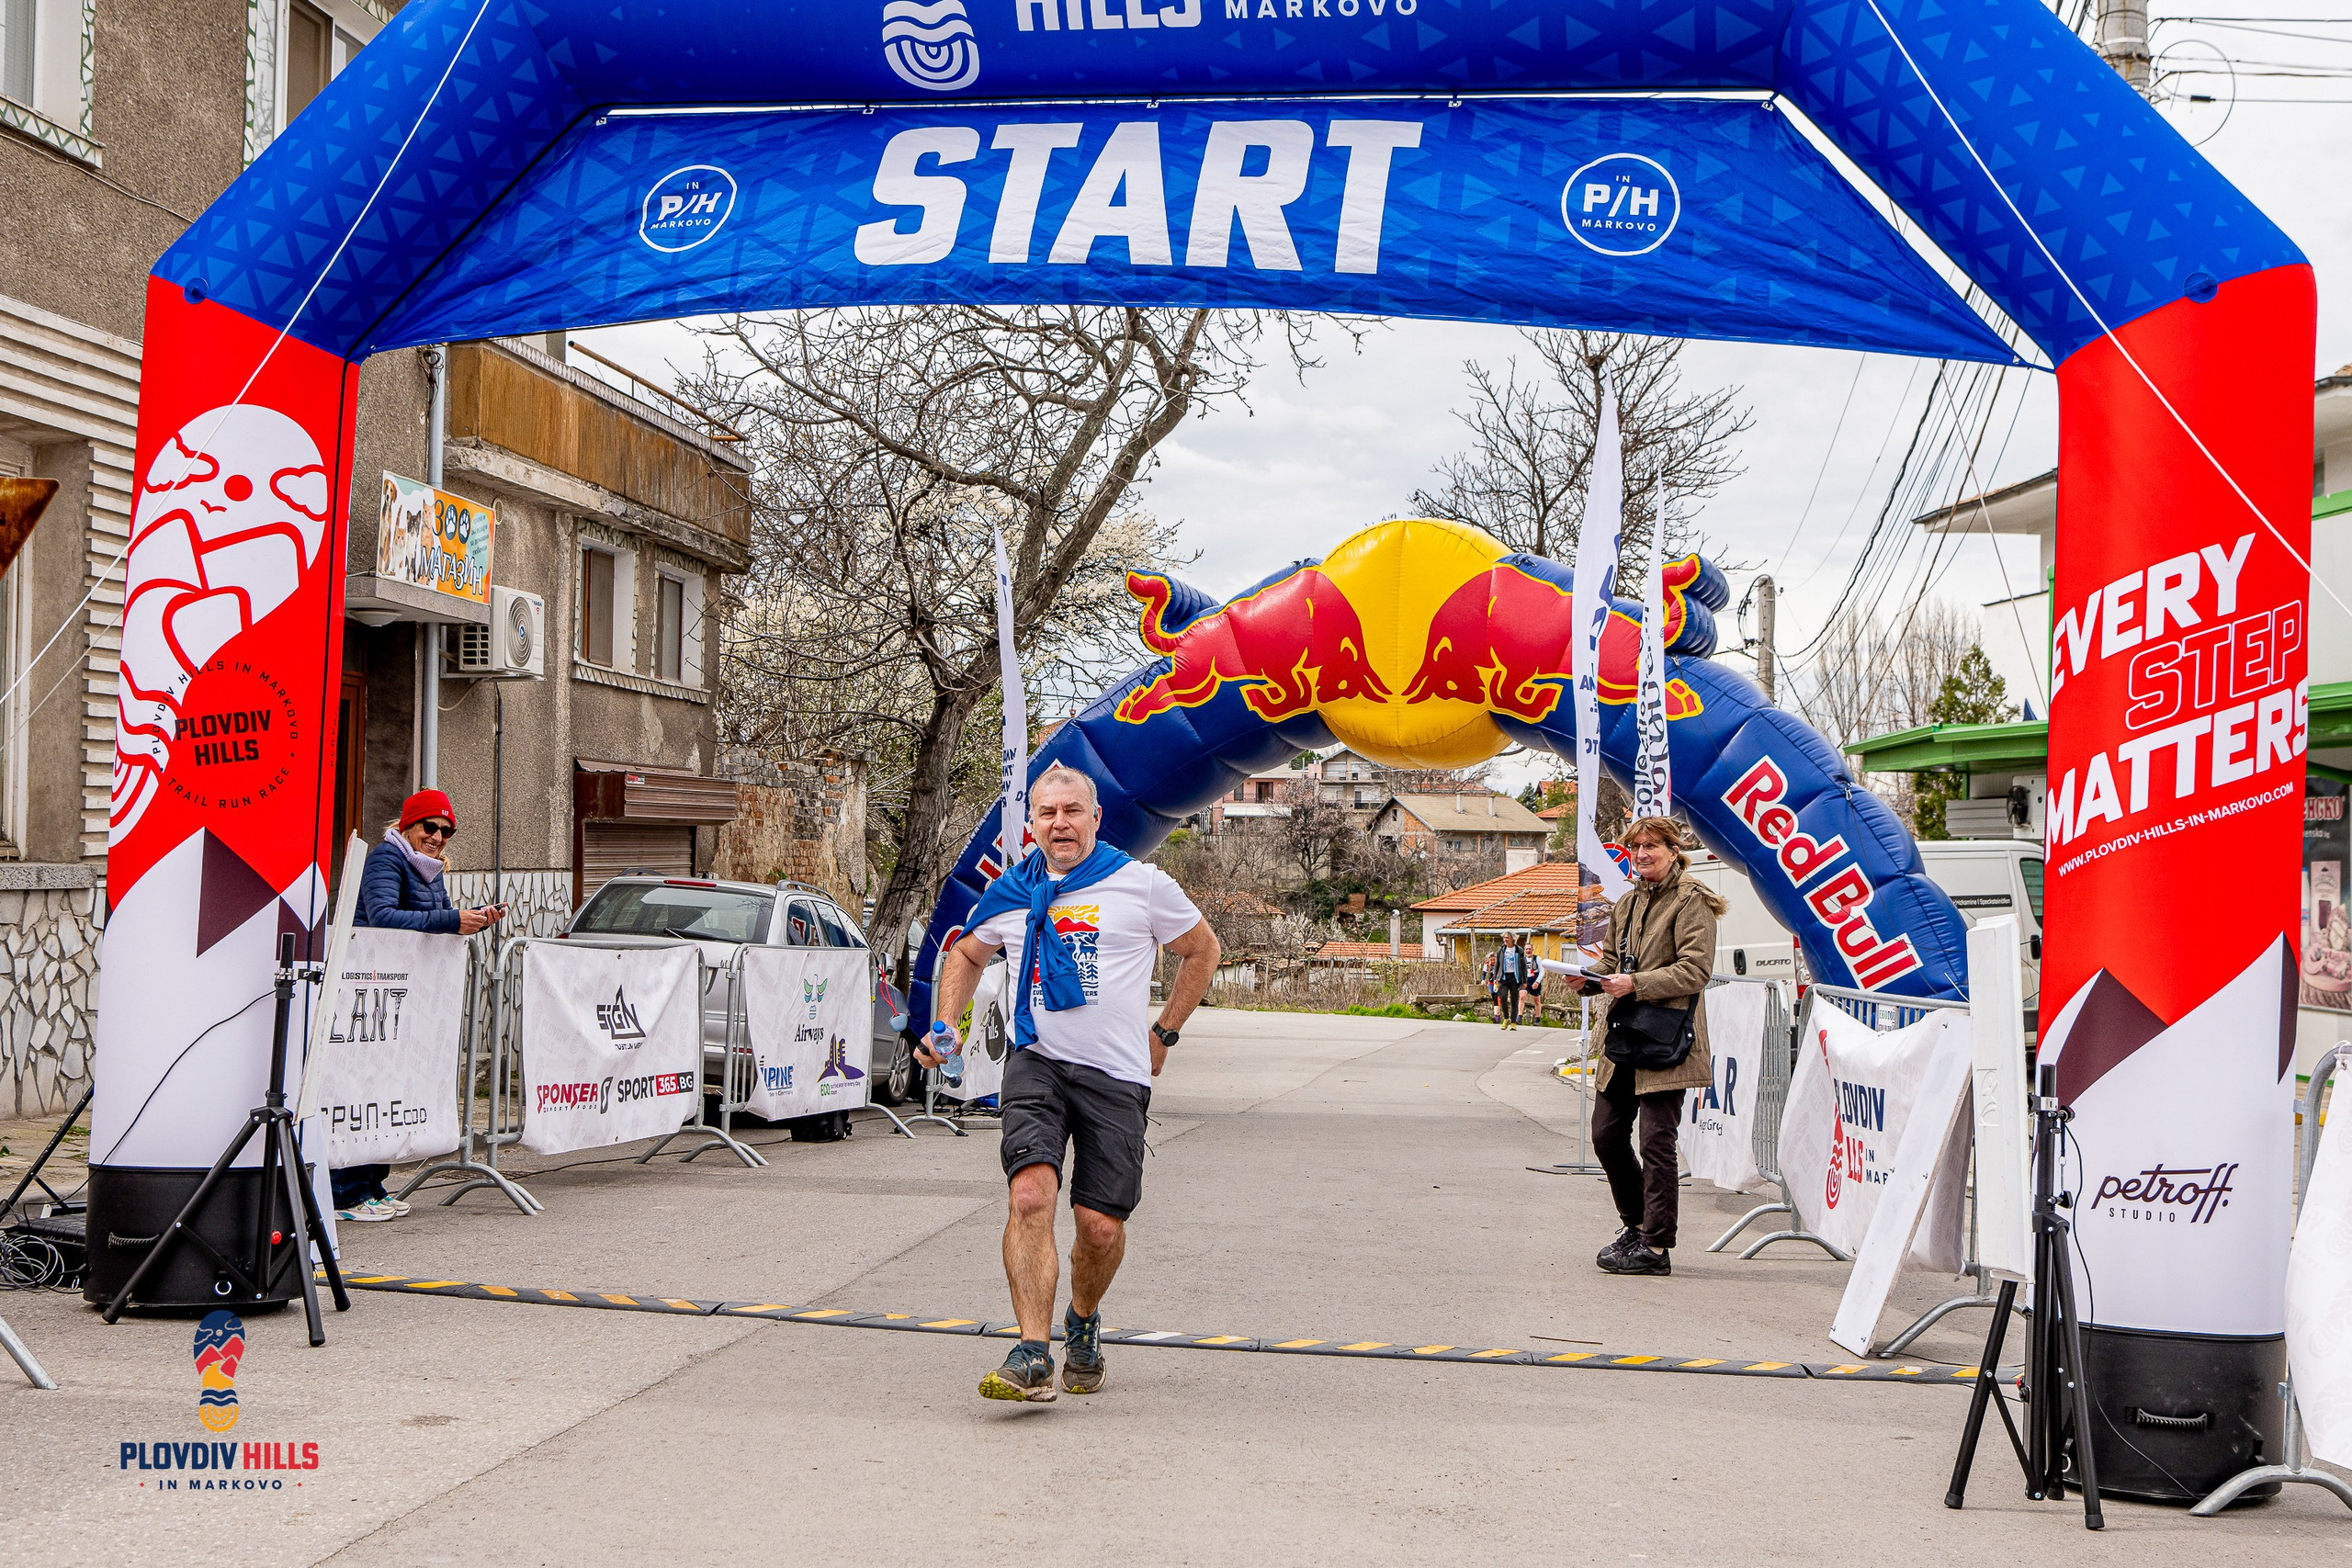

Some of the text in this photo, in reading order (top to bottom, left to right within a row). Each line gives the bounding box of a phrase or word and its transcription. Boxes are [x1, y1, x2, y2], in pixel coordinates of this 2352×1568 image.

[685, 181, 699, 190] IN
[1615, 175, 1631, 184] IN
[657, 191, 723, 221] P/H
[854, 119, 1424, 275] START
[1583, 183, 1659, 218] P/H
[650, 218, 711, 230] MARKOVO
[1581, 218, 1657, 231] MARKOVO
[420, 545, 484, 596] МАГАЗИН
[2051, 532, 2256, 705] EVERY
[2125, 599, 2302, 730] STEP
[152, 660, 299, 754] PLOVDIV HILLS IN MARKOVO
[175, 709, 271, 741] PLOVDIV
[194, 739, 260, 767] HILLS
[2045, 674, 2310, 865] MATTERS
[167, 766, 289, 809] TRAIL RUN RACE
[2058, 781, 2294, 877] WWW.PLOVDIV-HILLS-IN-MARKOVO.COM
[1724, 757, 1920, 991] Red Bull
[1756, 958, 1792, 966] DUCATO
[794, 1023, 824, 1044] Airways
[1865, 1147, 1875, 1163] IN
[2109, 1207, 2176, 1223] STUDIO
